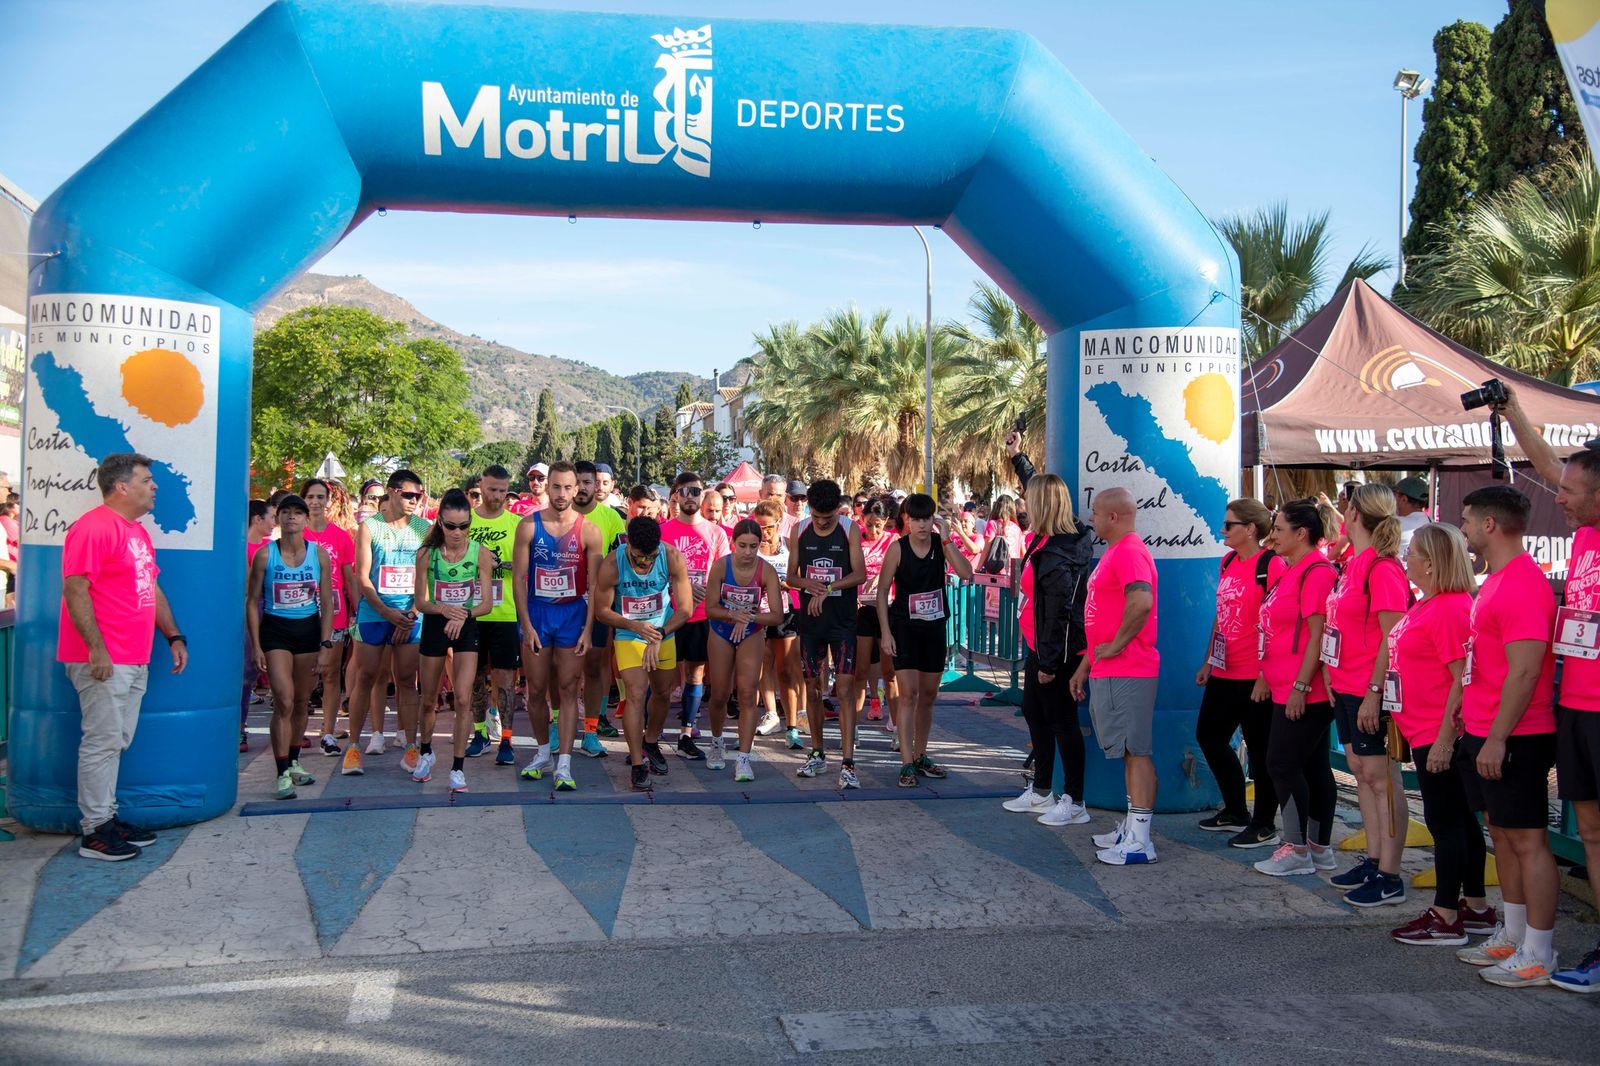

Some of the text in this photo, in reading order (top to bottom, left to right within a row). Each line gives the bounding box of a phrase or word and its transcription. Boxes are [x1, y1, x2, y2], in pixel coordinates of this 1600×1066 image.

[507, 84, 639, 108] Ayuntamiento de
[737, 99, 904, 132] DEPORTES
[32, 302, 212, 334] MANCOMUNIDAD
[31, 332, 210, 354] DE MUNICIPIOS
[1084, 335, 1237, 356] MANCOMUNIDAD
[1084, 362, 1236, 375] DE MUNICIPIOS
[28, 427, 71, 451] Costa
[1085, 450, 1142, 473] Costa
[26, 466, 98, 498] Tropical
[24, 508, 38, 533] De
[1144, 525, 1204, 547] anada
[274, 570, 313, 582] nerja
[390, 574, 409, 583] 372
[544, 577, 564, 586] 500
[623, 579, 657, 590] nerja
[284, 588, 305, 599] 582
[445, 588, 467, 598] 533
[730, 593, 750, 603] 532
[632, 601, 652, 610] 431
[919, 599, 937, 610] 378
[1576, 623, 1585, 638] 3
